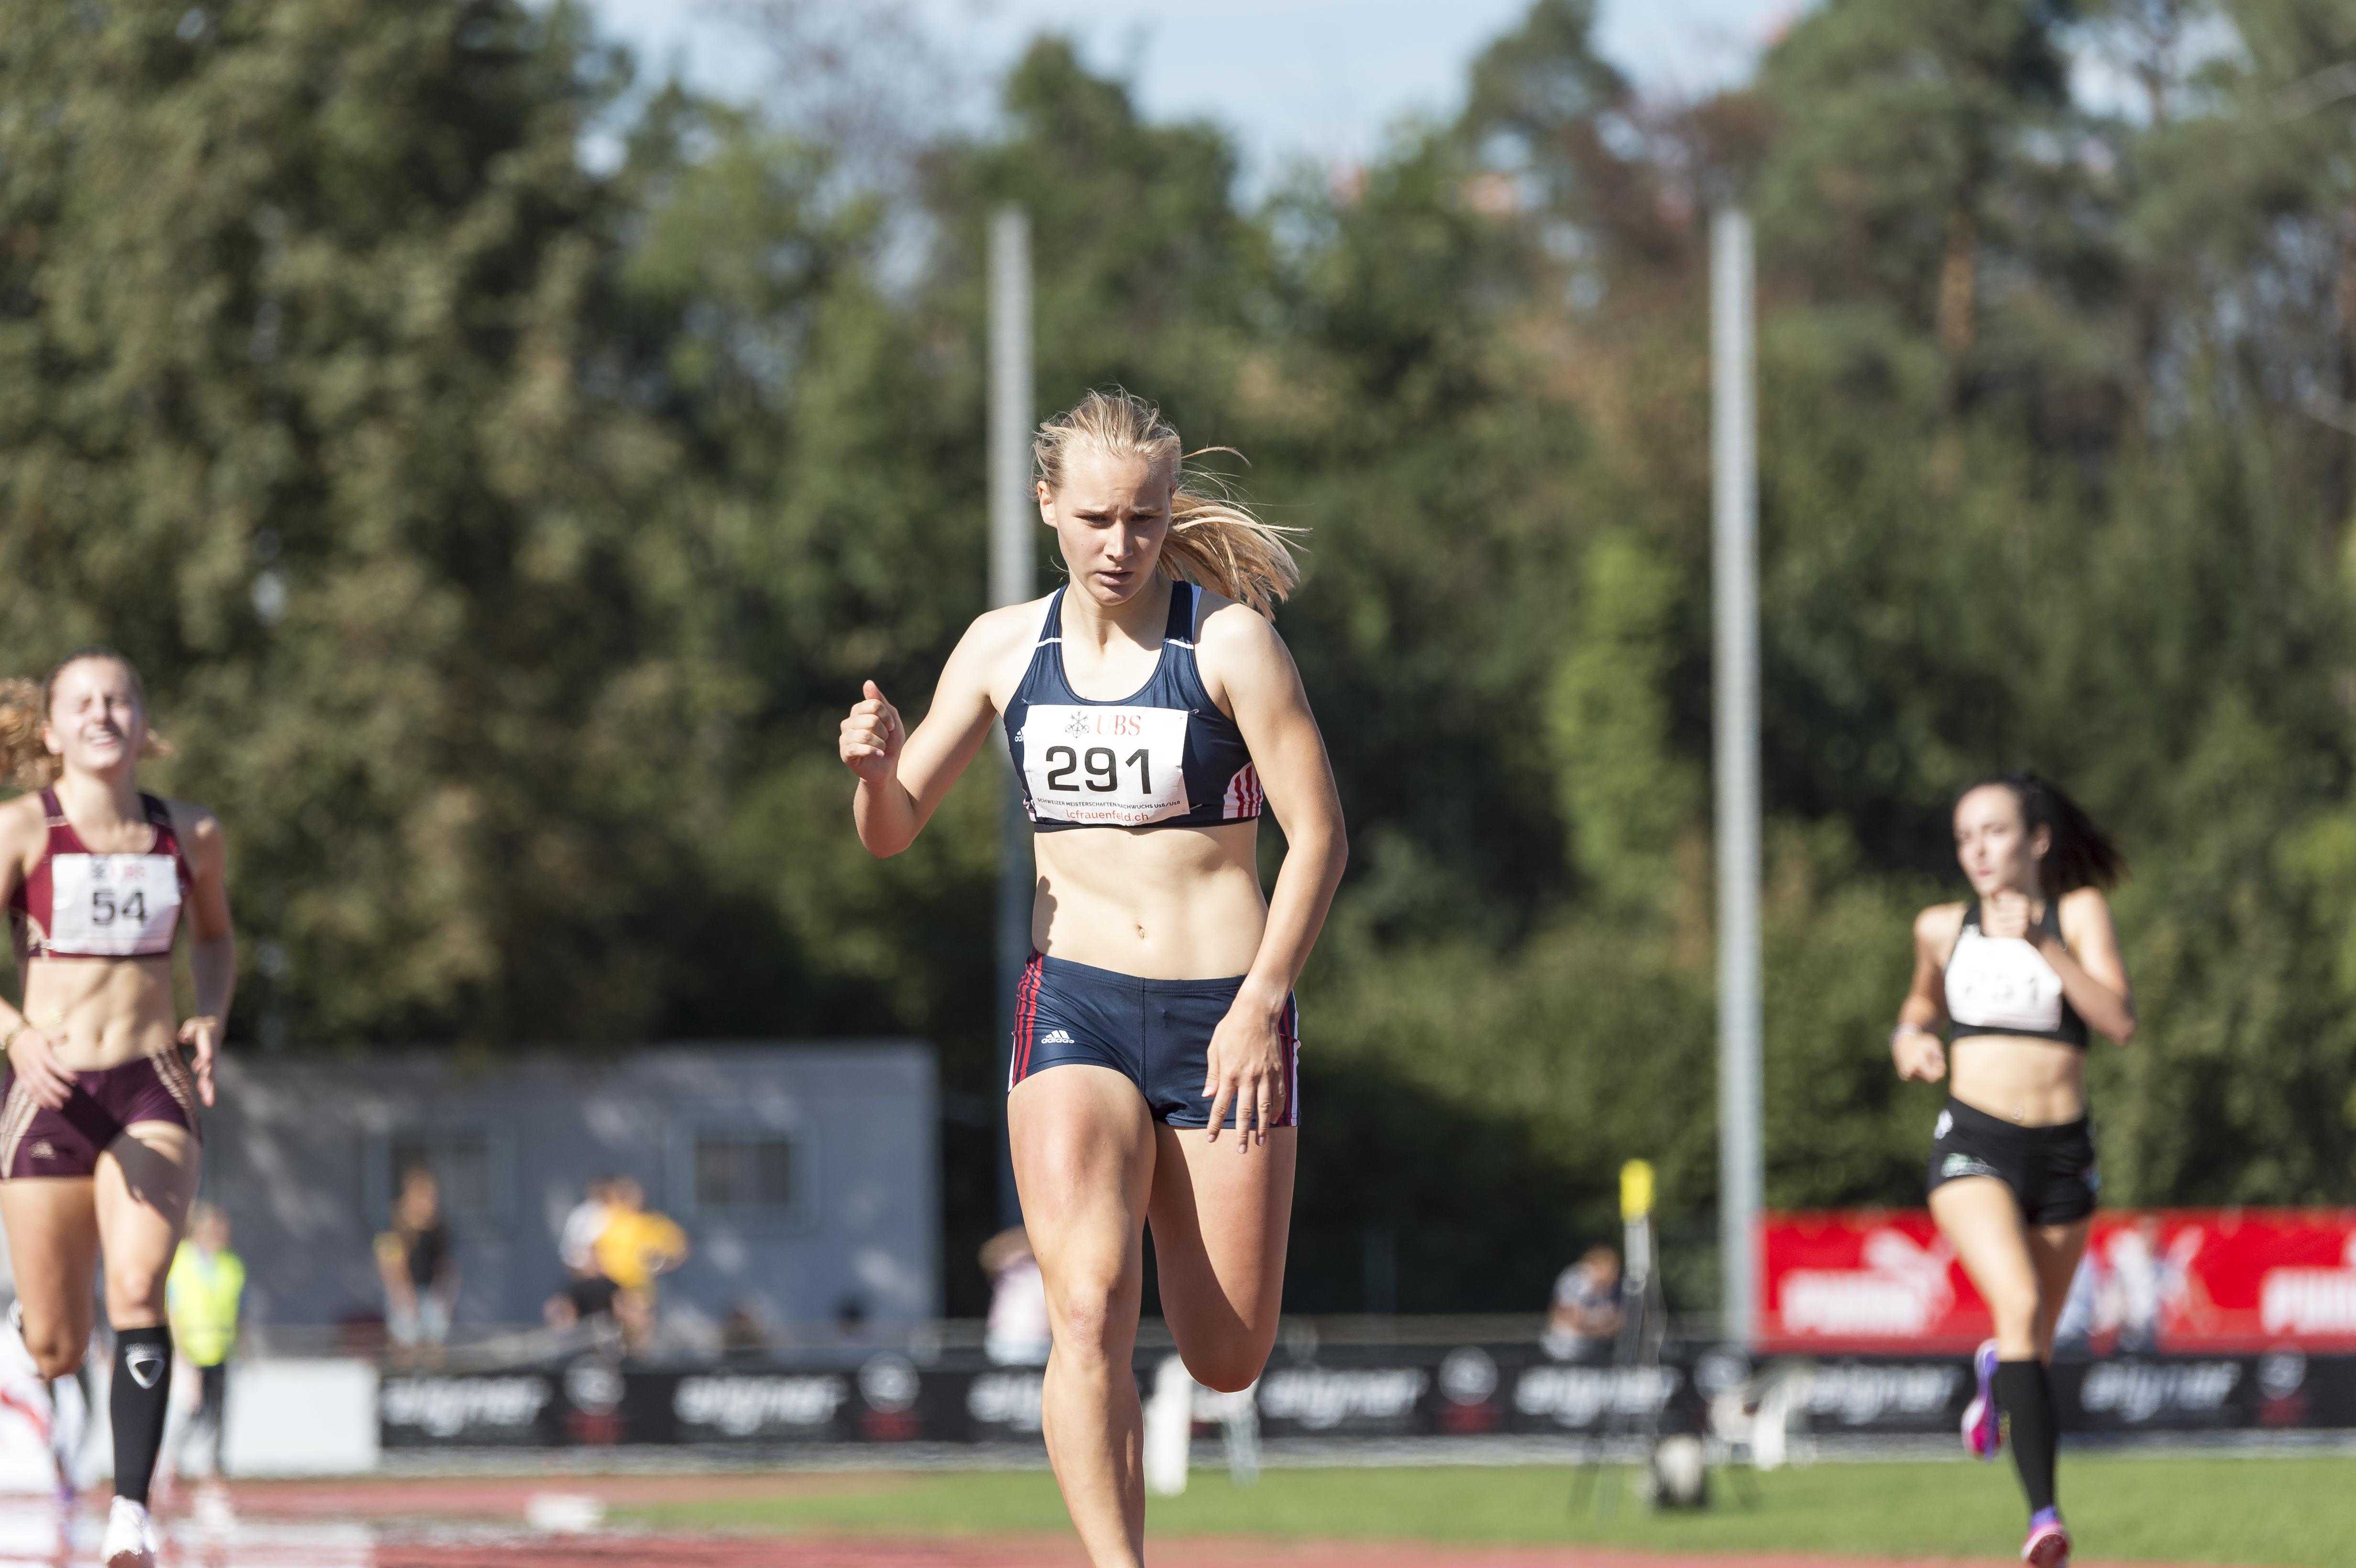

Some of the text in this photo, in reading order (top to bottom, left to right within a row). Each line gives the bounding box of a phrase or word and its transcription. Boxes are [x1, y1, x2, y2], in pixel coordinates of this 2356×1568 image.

[1097, 715, 1141, 736] UBS
[1046, 746, 1152, 794] 291
[1066, 809, 1149, 821] lcfrauenfeld.ch
[92, 888, 147, 927] 54
